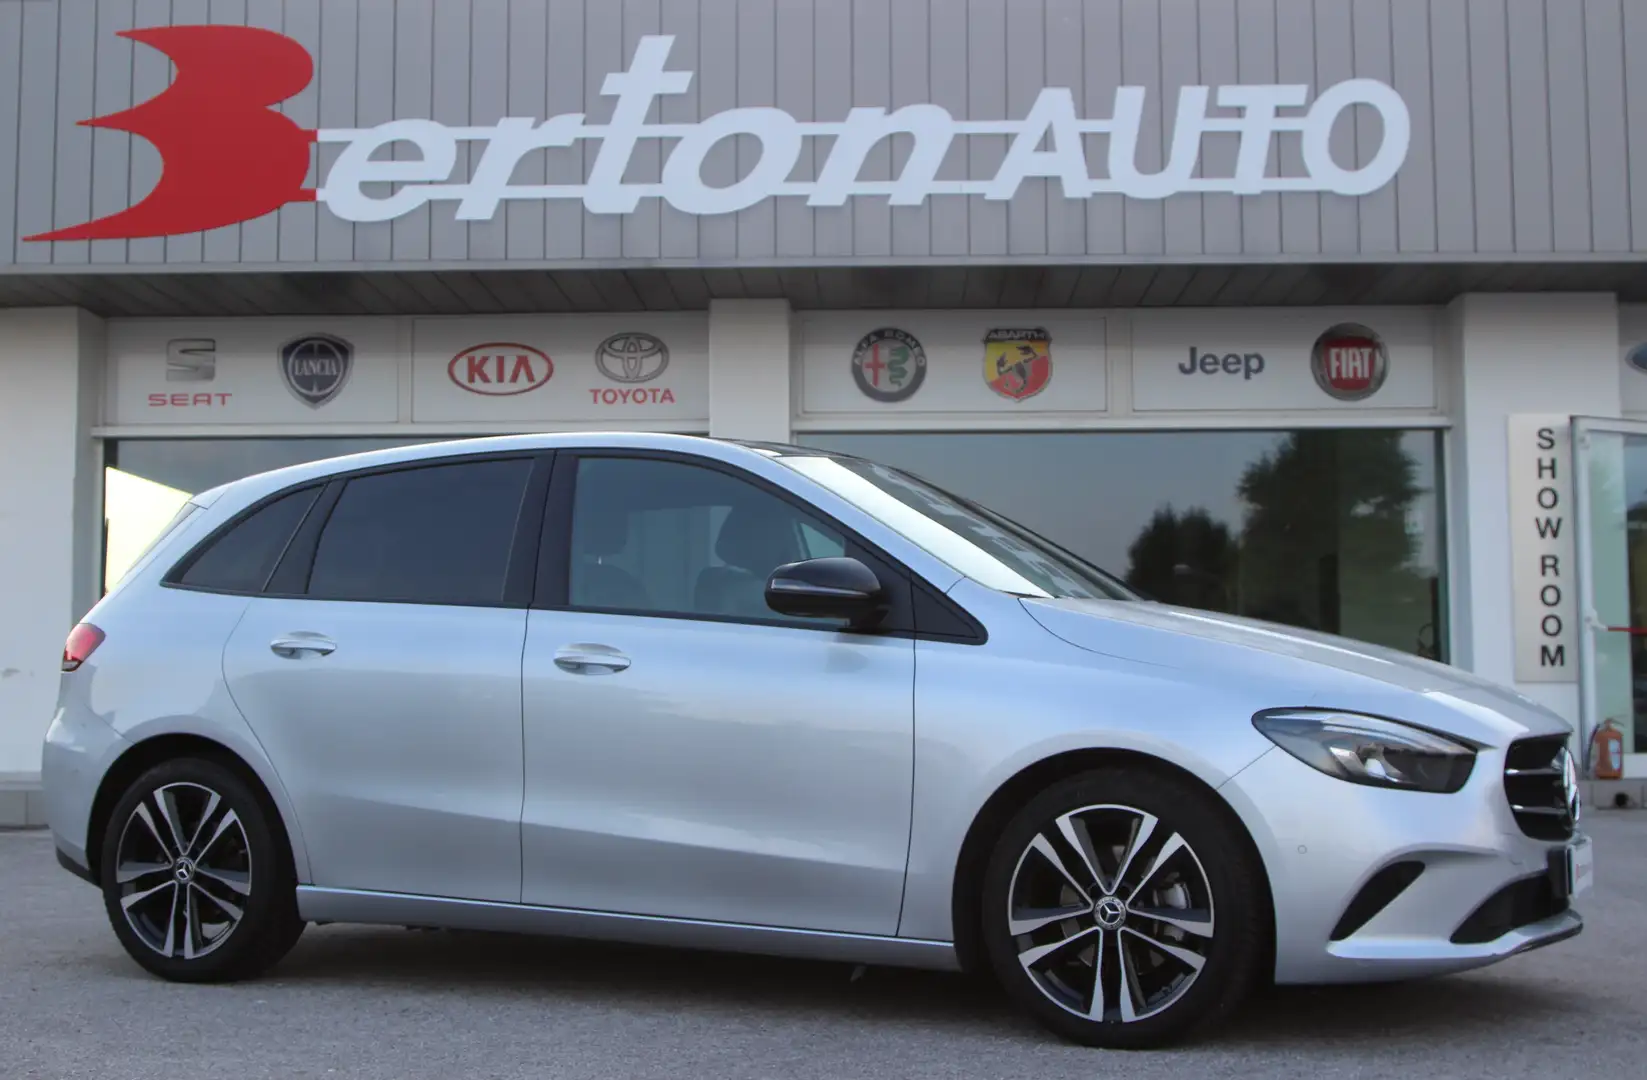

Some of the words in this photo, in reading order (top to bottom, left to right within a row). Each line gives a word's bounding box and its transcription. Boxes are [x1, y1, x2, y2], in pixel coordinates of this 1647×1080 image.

[23, 24, 954, 242] Berton
[985, 78, 1411, 199] AUTO
[988, 329, 1047, 341] ABARTH
[294, 358, 338, 377] LANCIA
[467, 355, 536, 384] KIA
[1178, 346, 1265, 380] Jeep
[1329, 348, 1373, 380] FIAT
[148, 393, 233, 407] SEAT
[589, 388, 676, 405] TOYOTA
